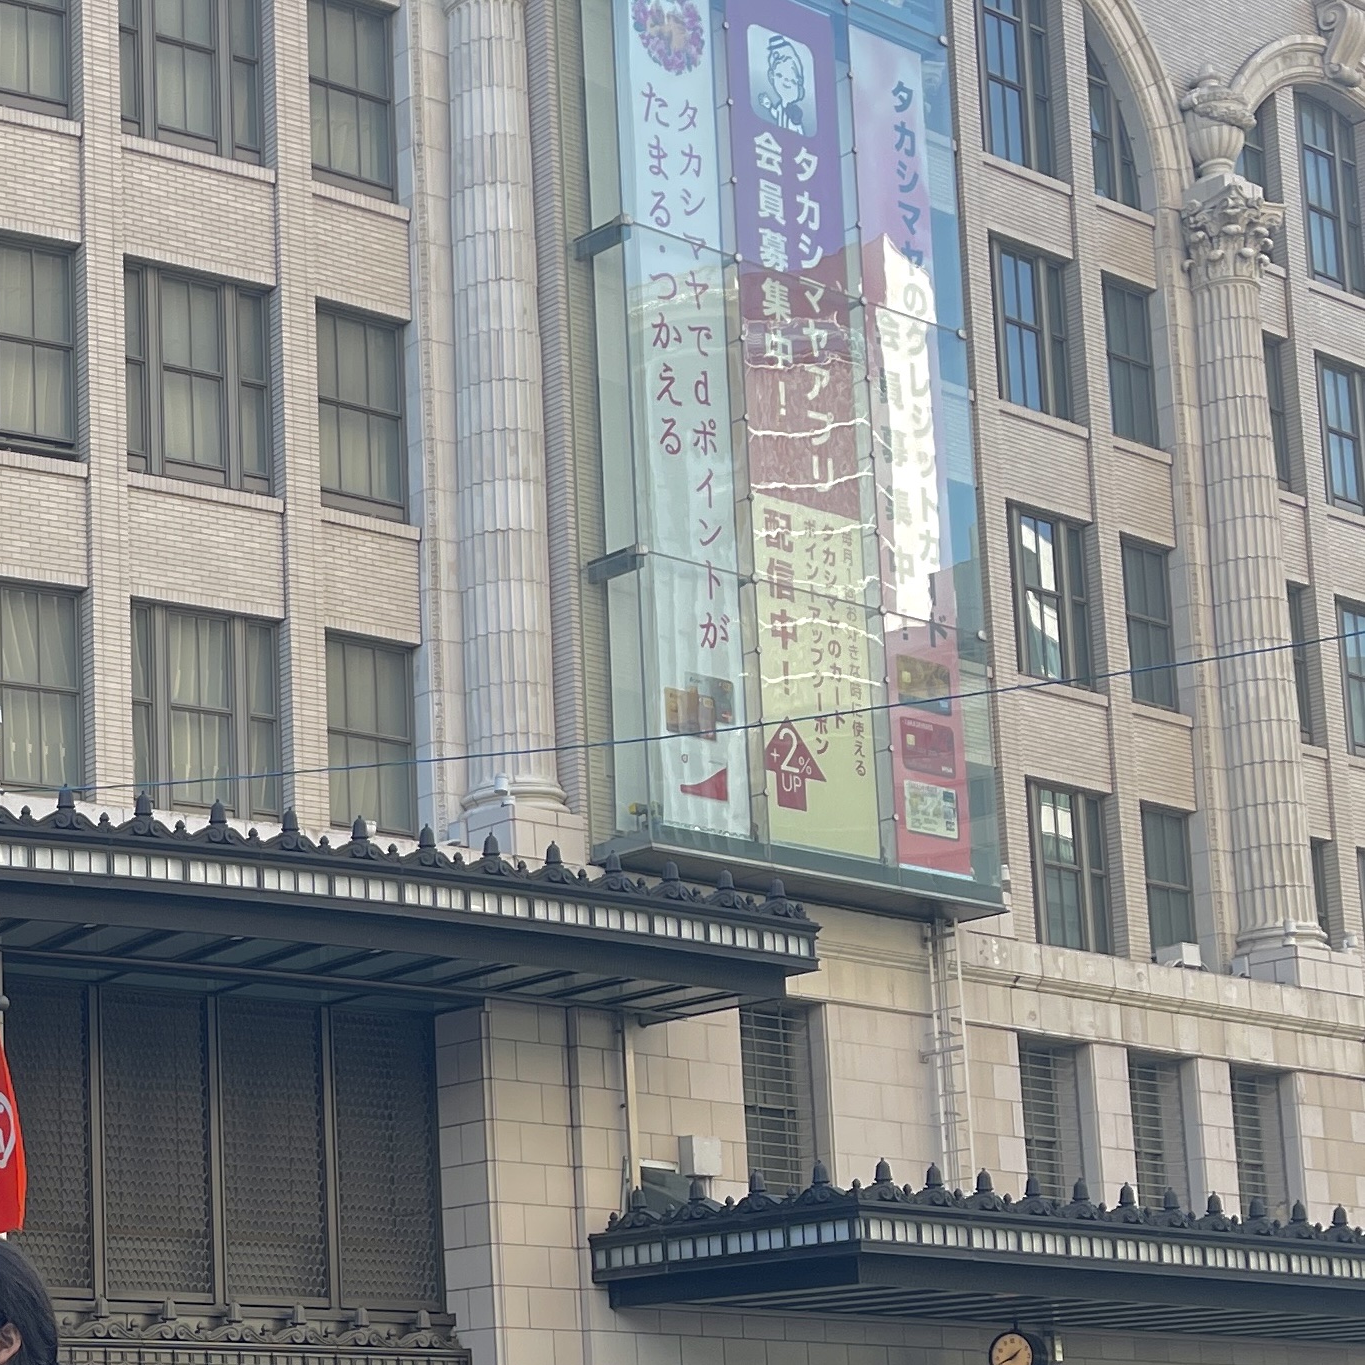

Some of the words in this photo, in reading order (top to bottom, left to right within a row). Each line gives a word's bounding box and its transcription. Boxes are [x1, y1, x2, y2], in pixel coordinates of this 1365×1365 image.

[641, 82, 683, 456] たまる・つかえる
[678, 99, 731, 649] タカシマヤでdポイントが
[794, 146, 834, 492] タカシマヤアプリ
[770, 728, 812, 775] +2%
[781, 772, 802, 793] UP
